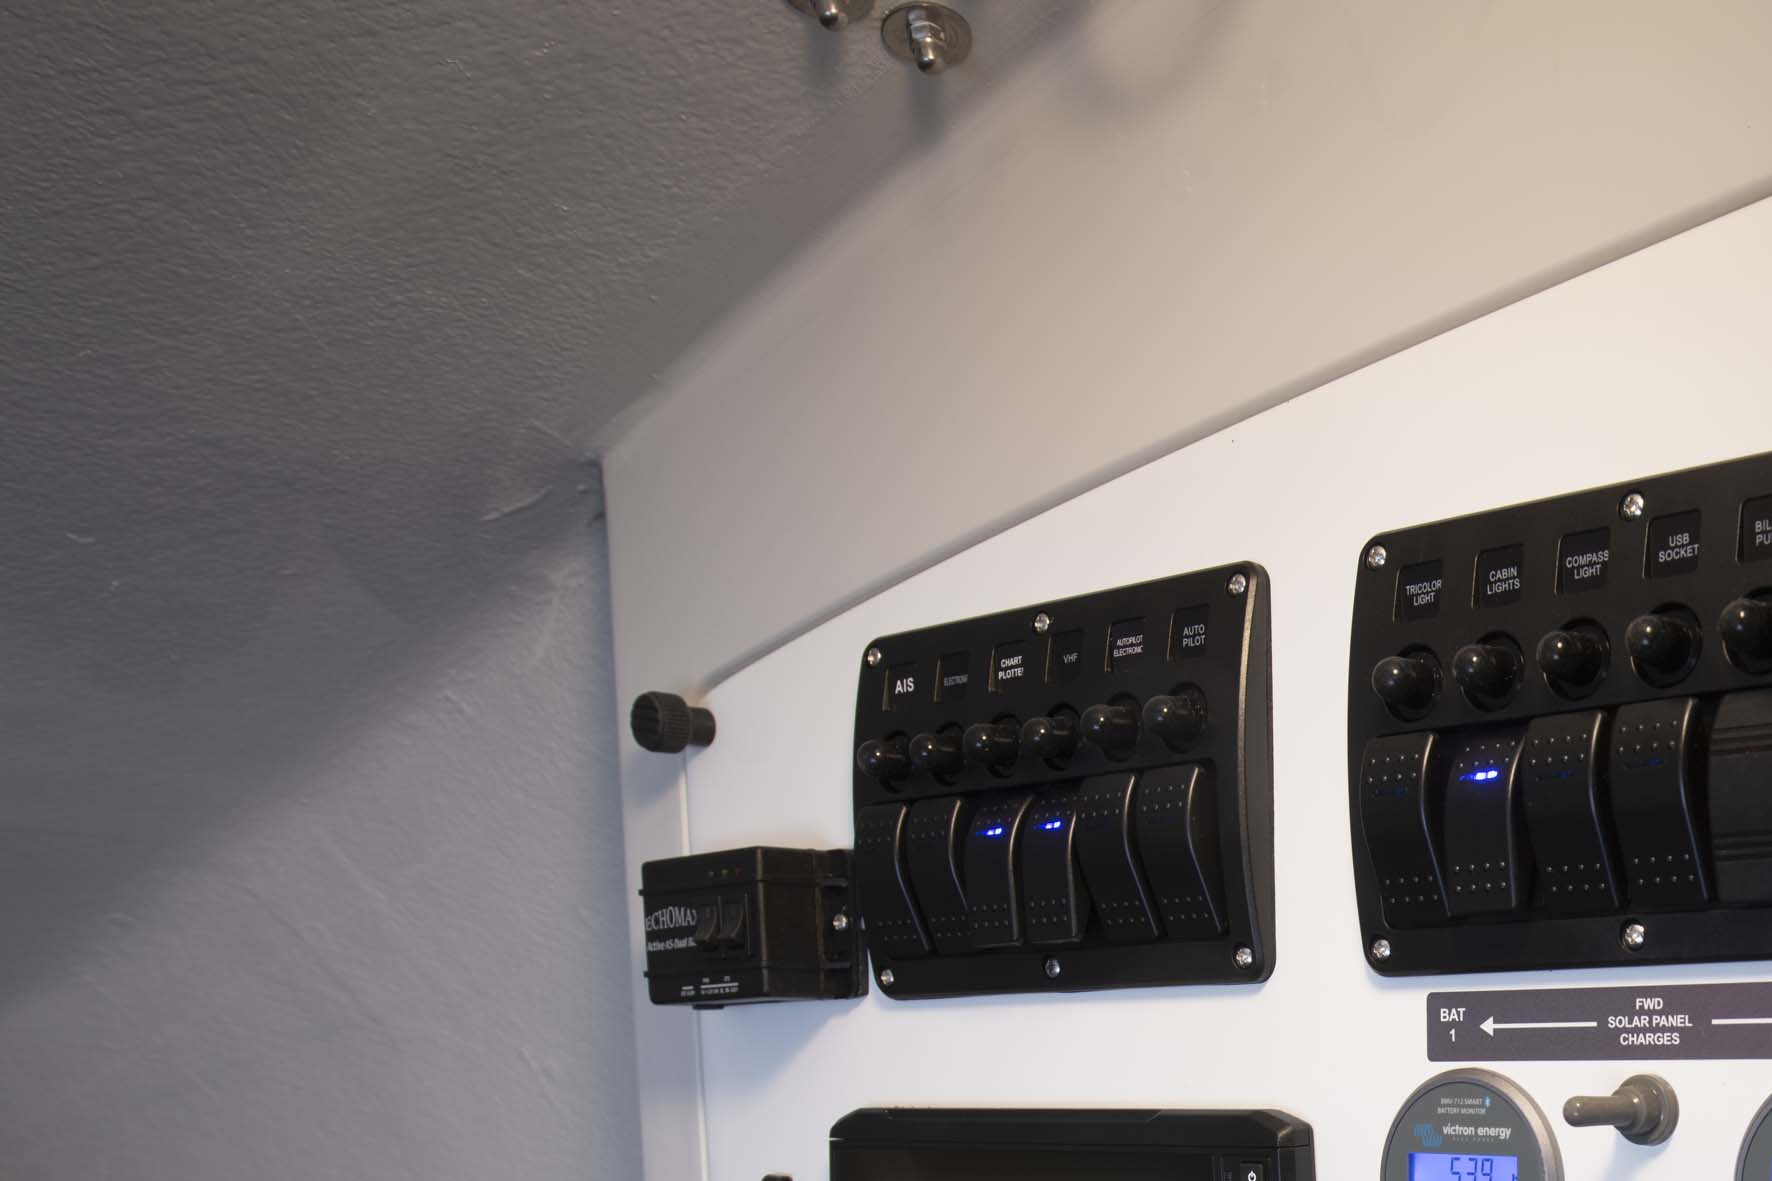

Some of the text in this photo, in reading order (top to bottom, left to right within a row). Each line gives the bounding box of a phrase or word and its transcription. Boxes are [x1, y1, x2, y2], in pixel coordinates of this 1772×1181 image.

[1668, 532, 1690, 547] USB
[1565, 550, 1609, 569] COMPASS
[1658, 544, 1699, 563] SOCKET
[1489, 566, 1518, 582] CABIN
[1574, 564, 1601, 580] LIGHT
[1406, 579, 1442, 596] TRICOLOR
[1487, 578, 1521, 595] LIGHTS
[1413, 592, 1435, 606] LIGHT
[1183, 624, 1205, 636] AUTO
[1116, 635, 1143, 646] AUTOPILOT
[1182, 635, 1206, 649] PILOT
[1000, 655, 1023, 668] CHART
[1063, 652, 1078, 664] VHF
[895, 677, 915, 695] AIS
[1635, 998, 1664, 1010] FWD
[1440, 1007, 1466, 1022] BAT
[1607, 1015, 1693, 1028] SOLAR PANEL
[1449, 1028, 1456, 1042] 1
[1619, 1033, 1681, 1046] CHARGES
[1442, 1123, 1512, 1139] victron energy
